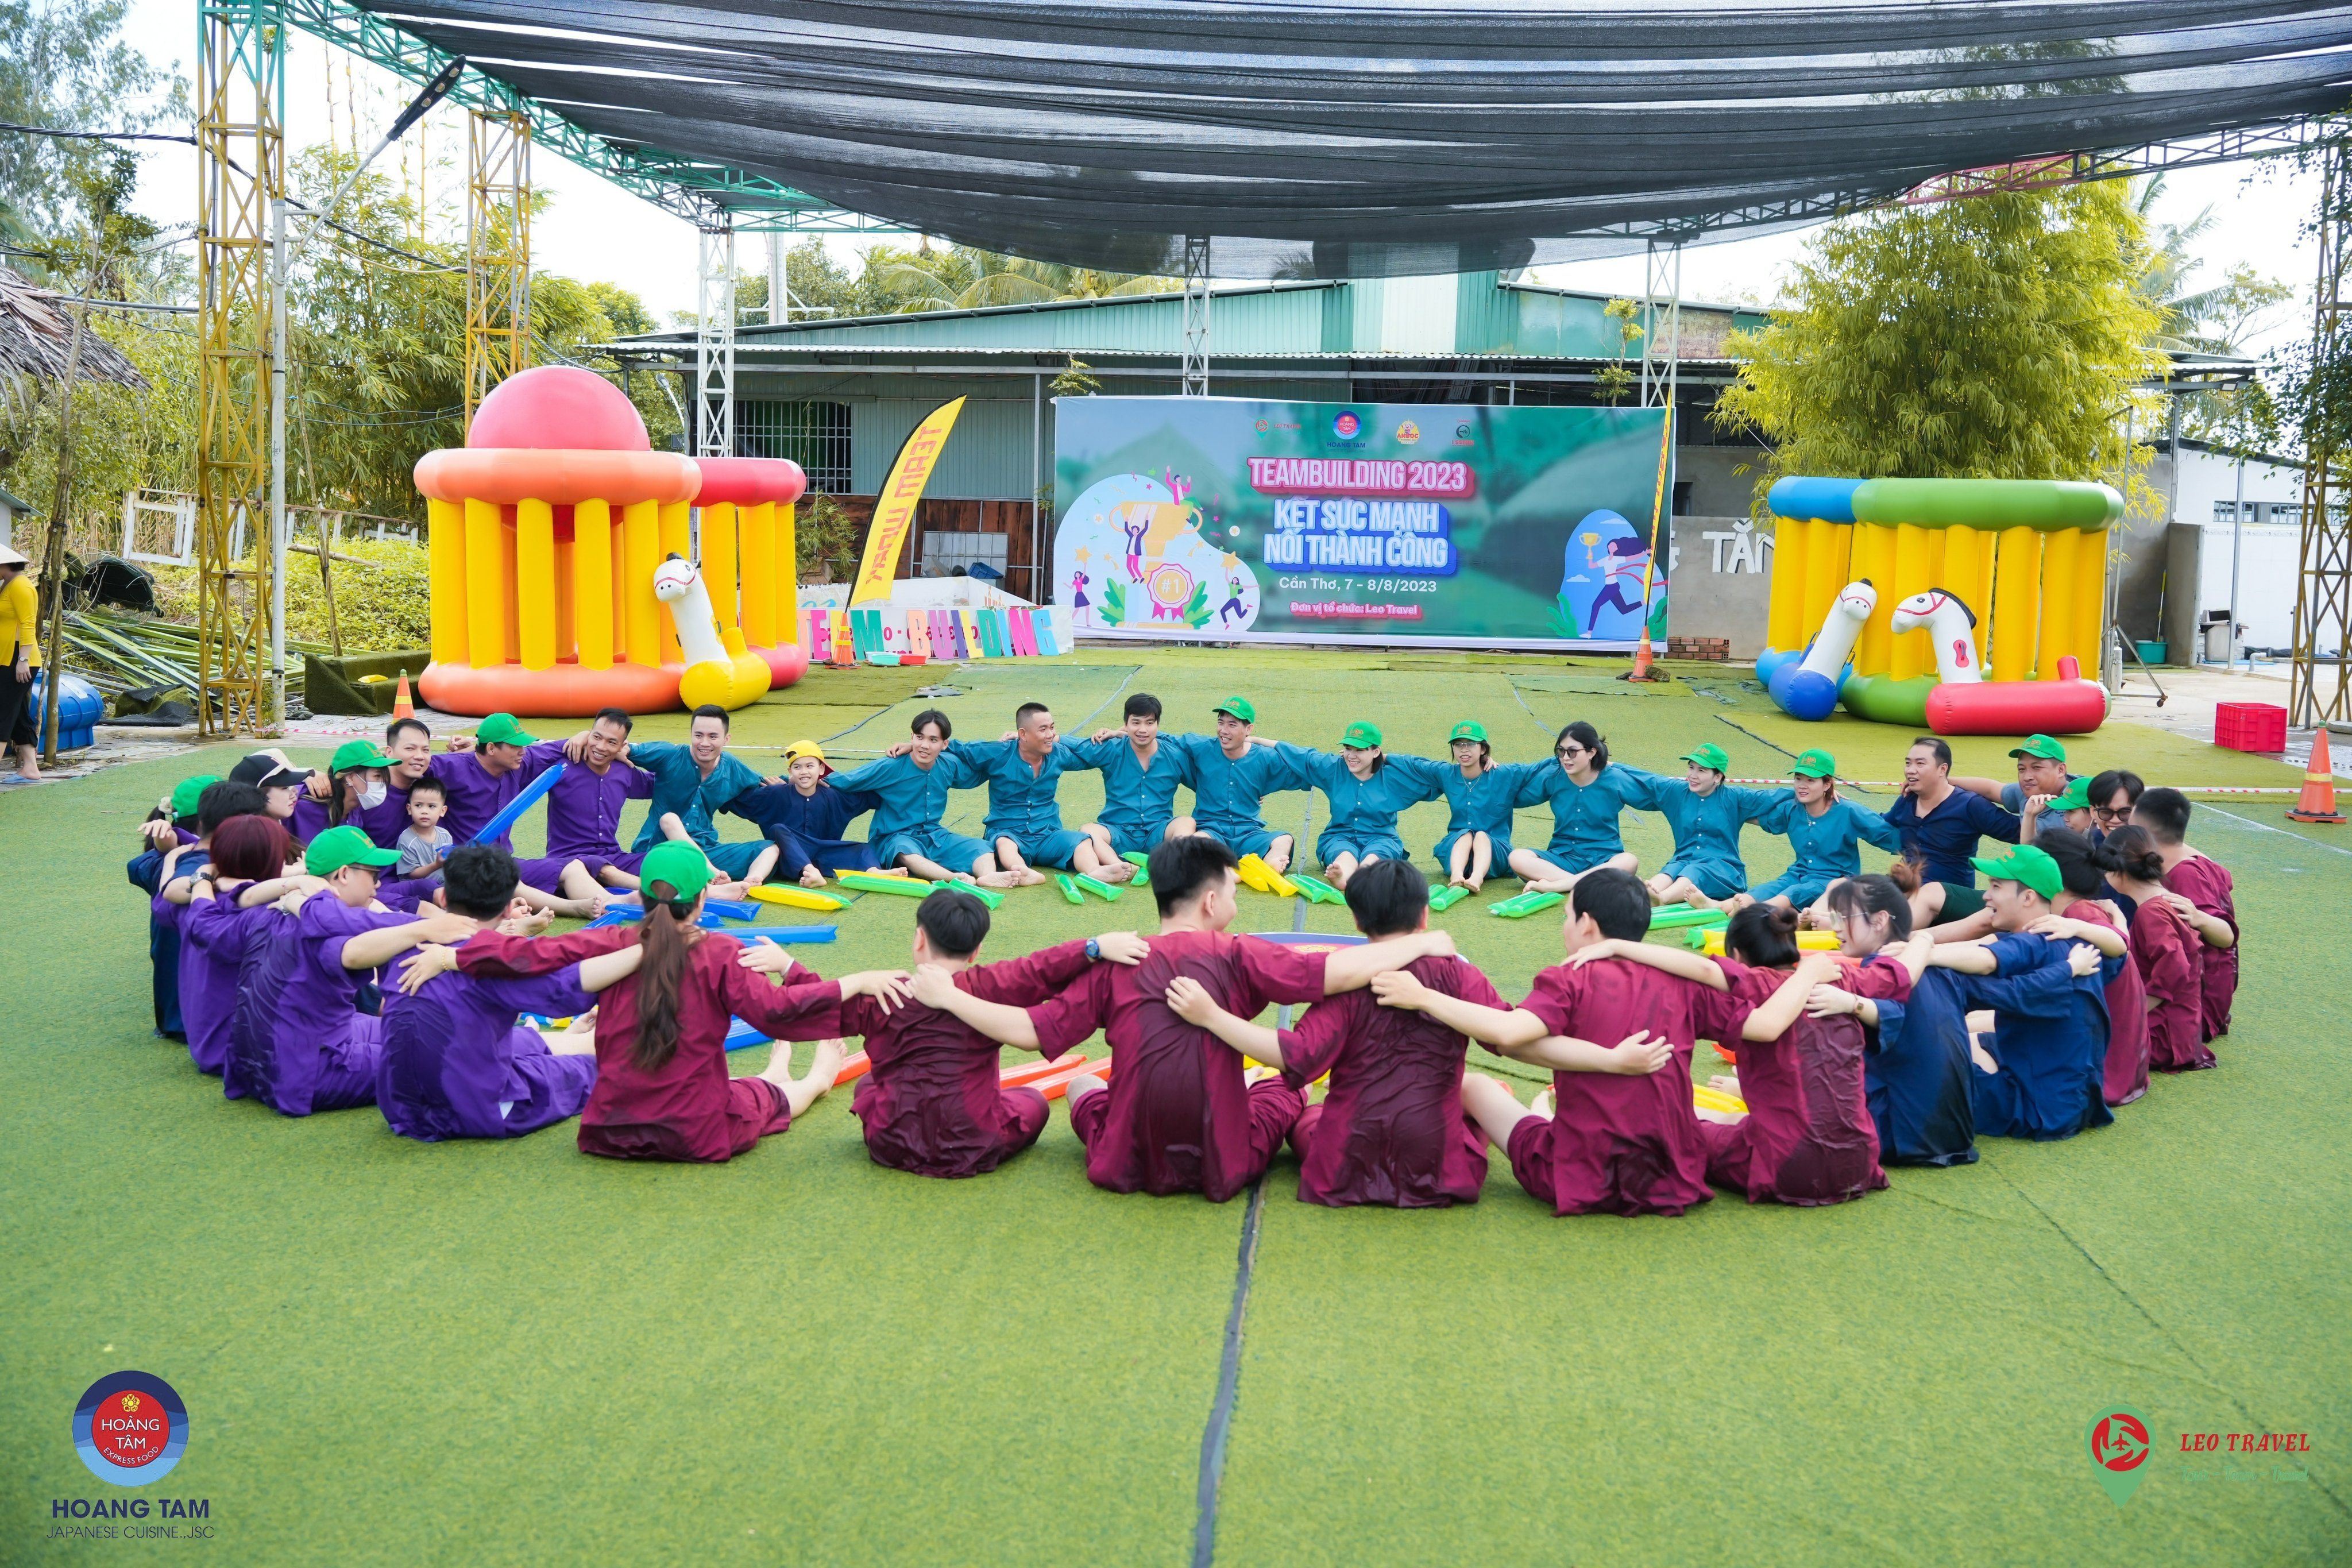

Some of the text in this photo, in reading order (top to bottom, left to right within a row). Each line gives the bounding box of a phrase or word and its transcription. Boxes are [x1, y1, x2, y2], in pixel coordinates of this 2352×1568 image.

[1249, 458, 1467, 491] TEAMBUILDING 2023
[1274, 495, 1440, 536] KẾT SỨC MẠNH
[1264, 528, 1449, 568] NỐI THÀNH CÔNG
[1161, 578, 1180, 594] #1
[1279, 576, 1307, 589] Cần
[1310, 578, 1341, 592] Thơ,
[1345, 579, 1353, 590] 7
[1367, 578, 1437, 594] 8/8/2023
[1291, 601, 1311, 612] Đơn
[1311, 602, 1322, 615] vị
[1337, 603, 1365, 613] chức:
[1365, 603, 1385, 614] Leo
[1385, 604, 1418, 615] Travel
[906, 609, 1060, 661] BUILDING
